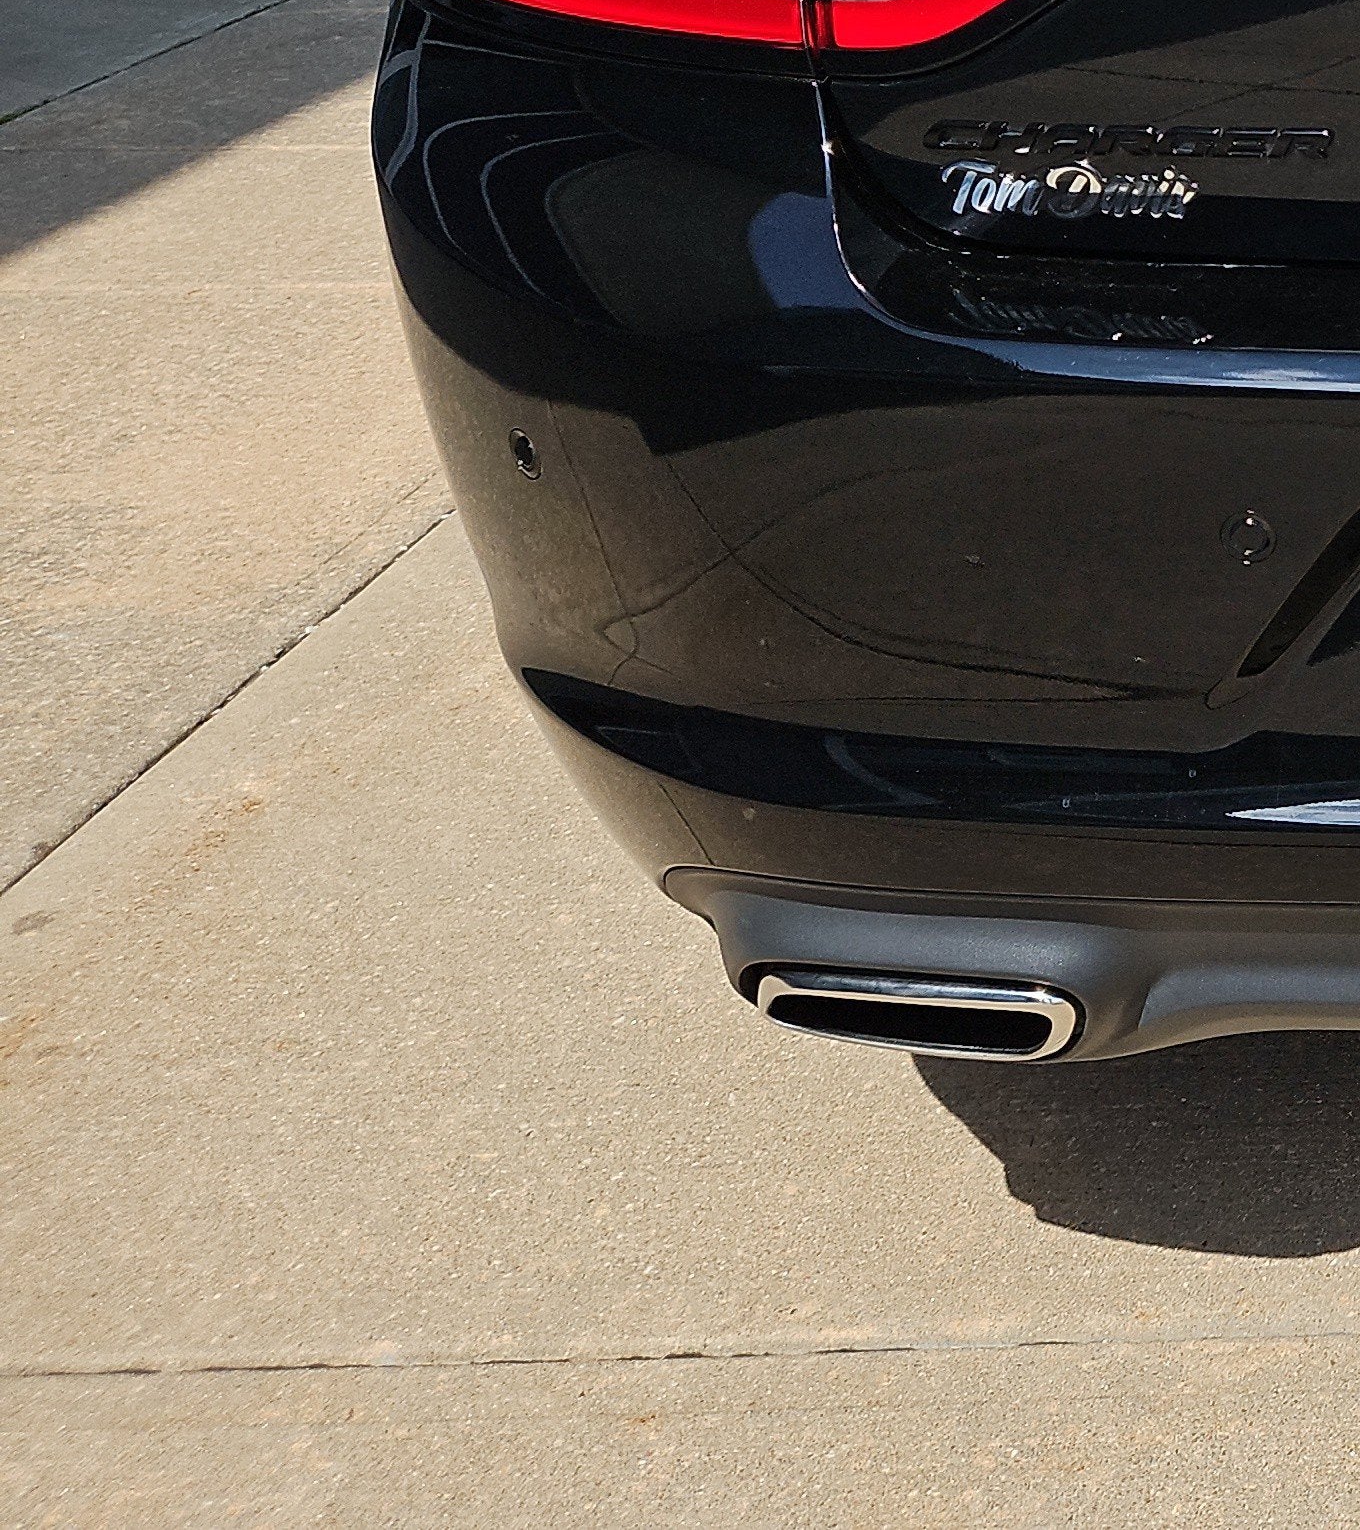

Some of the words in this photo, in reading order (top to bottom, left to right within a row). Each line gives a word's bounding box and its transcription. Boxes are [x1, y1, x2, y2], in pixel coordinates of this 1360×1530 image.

[923, 118, 1337, 160] CHARGER
[940, 158, 1044, 217] Tom
[1045, 160, 1201, 220] Davis
